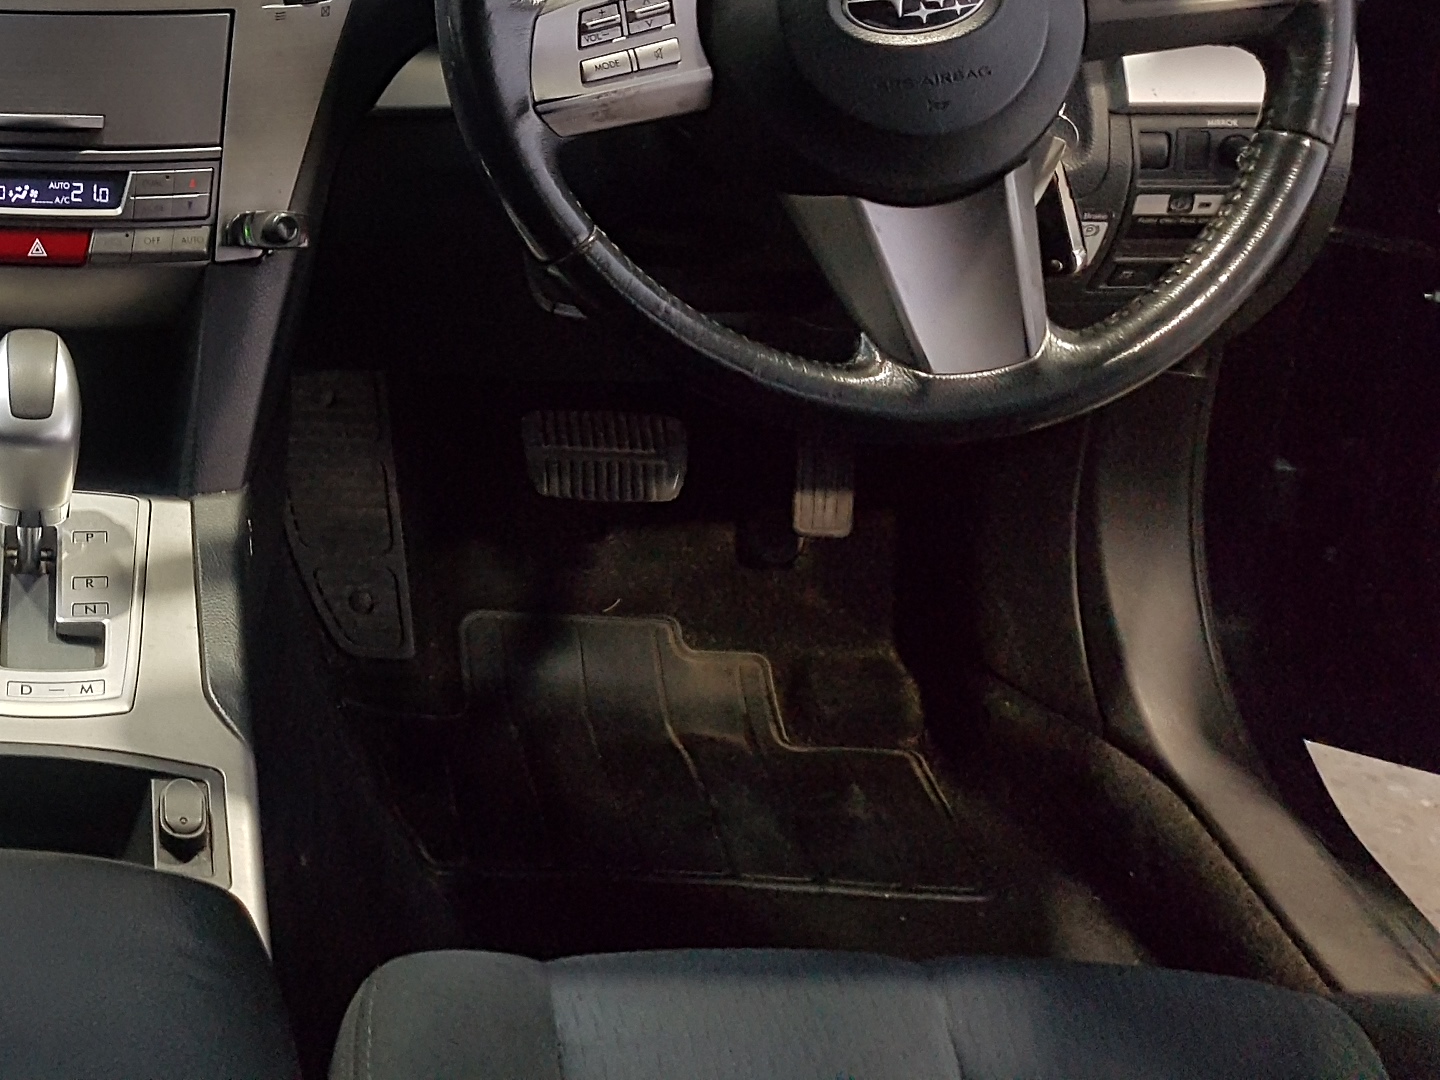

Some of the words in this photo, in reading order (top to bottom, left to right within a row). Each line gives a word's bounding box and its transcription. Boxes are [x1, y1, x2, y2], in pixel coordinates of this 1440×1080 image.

[583, 33, 603, 43] VOL
[594, 60, 621, 71] MODE
[48, 181, 71, 190] AUTO
[54, 196, 70, 204] A/C
[143, 236, 161, 246] OFF
[181, 236, 205, 245] AUTO
[85, 533, 95, 542] P
[85, 579, 94, 588] R
[85, 605, 96, 614] N
[21, 684, 33, 695] D
[79, 684, 95, 694] M
